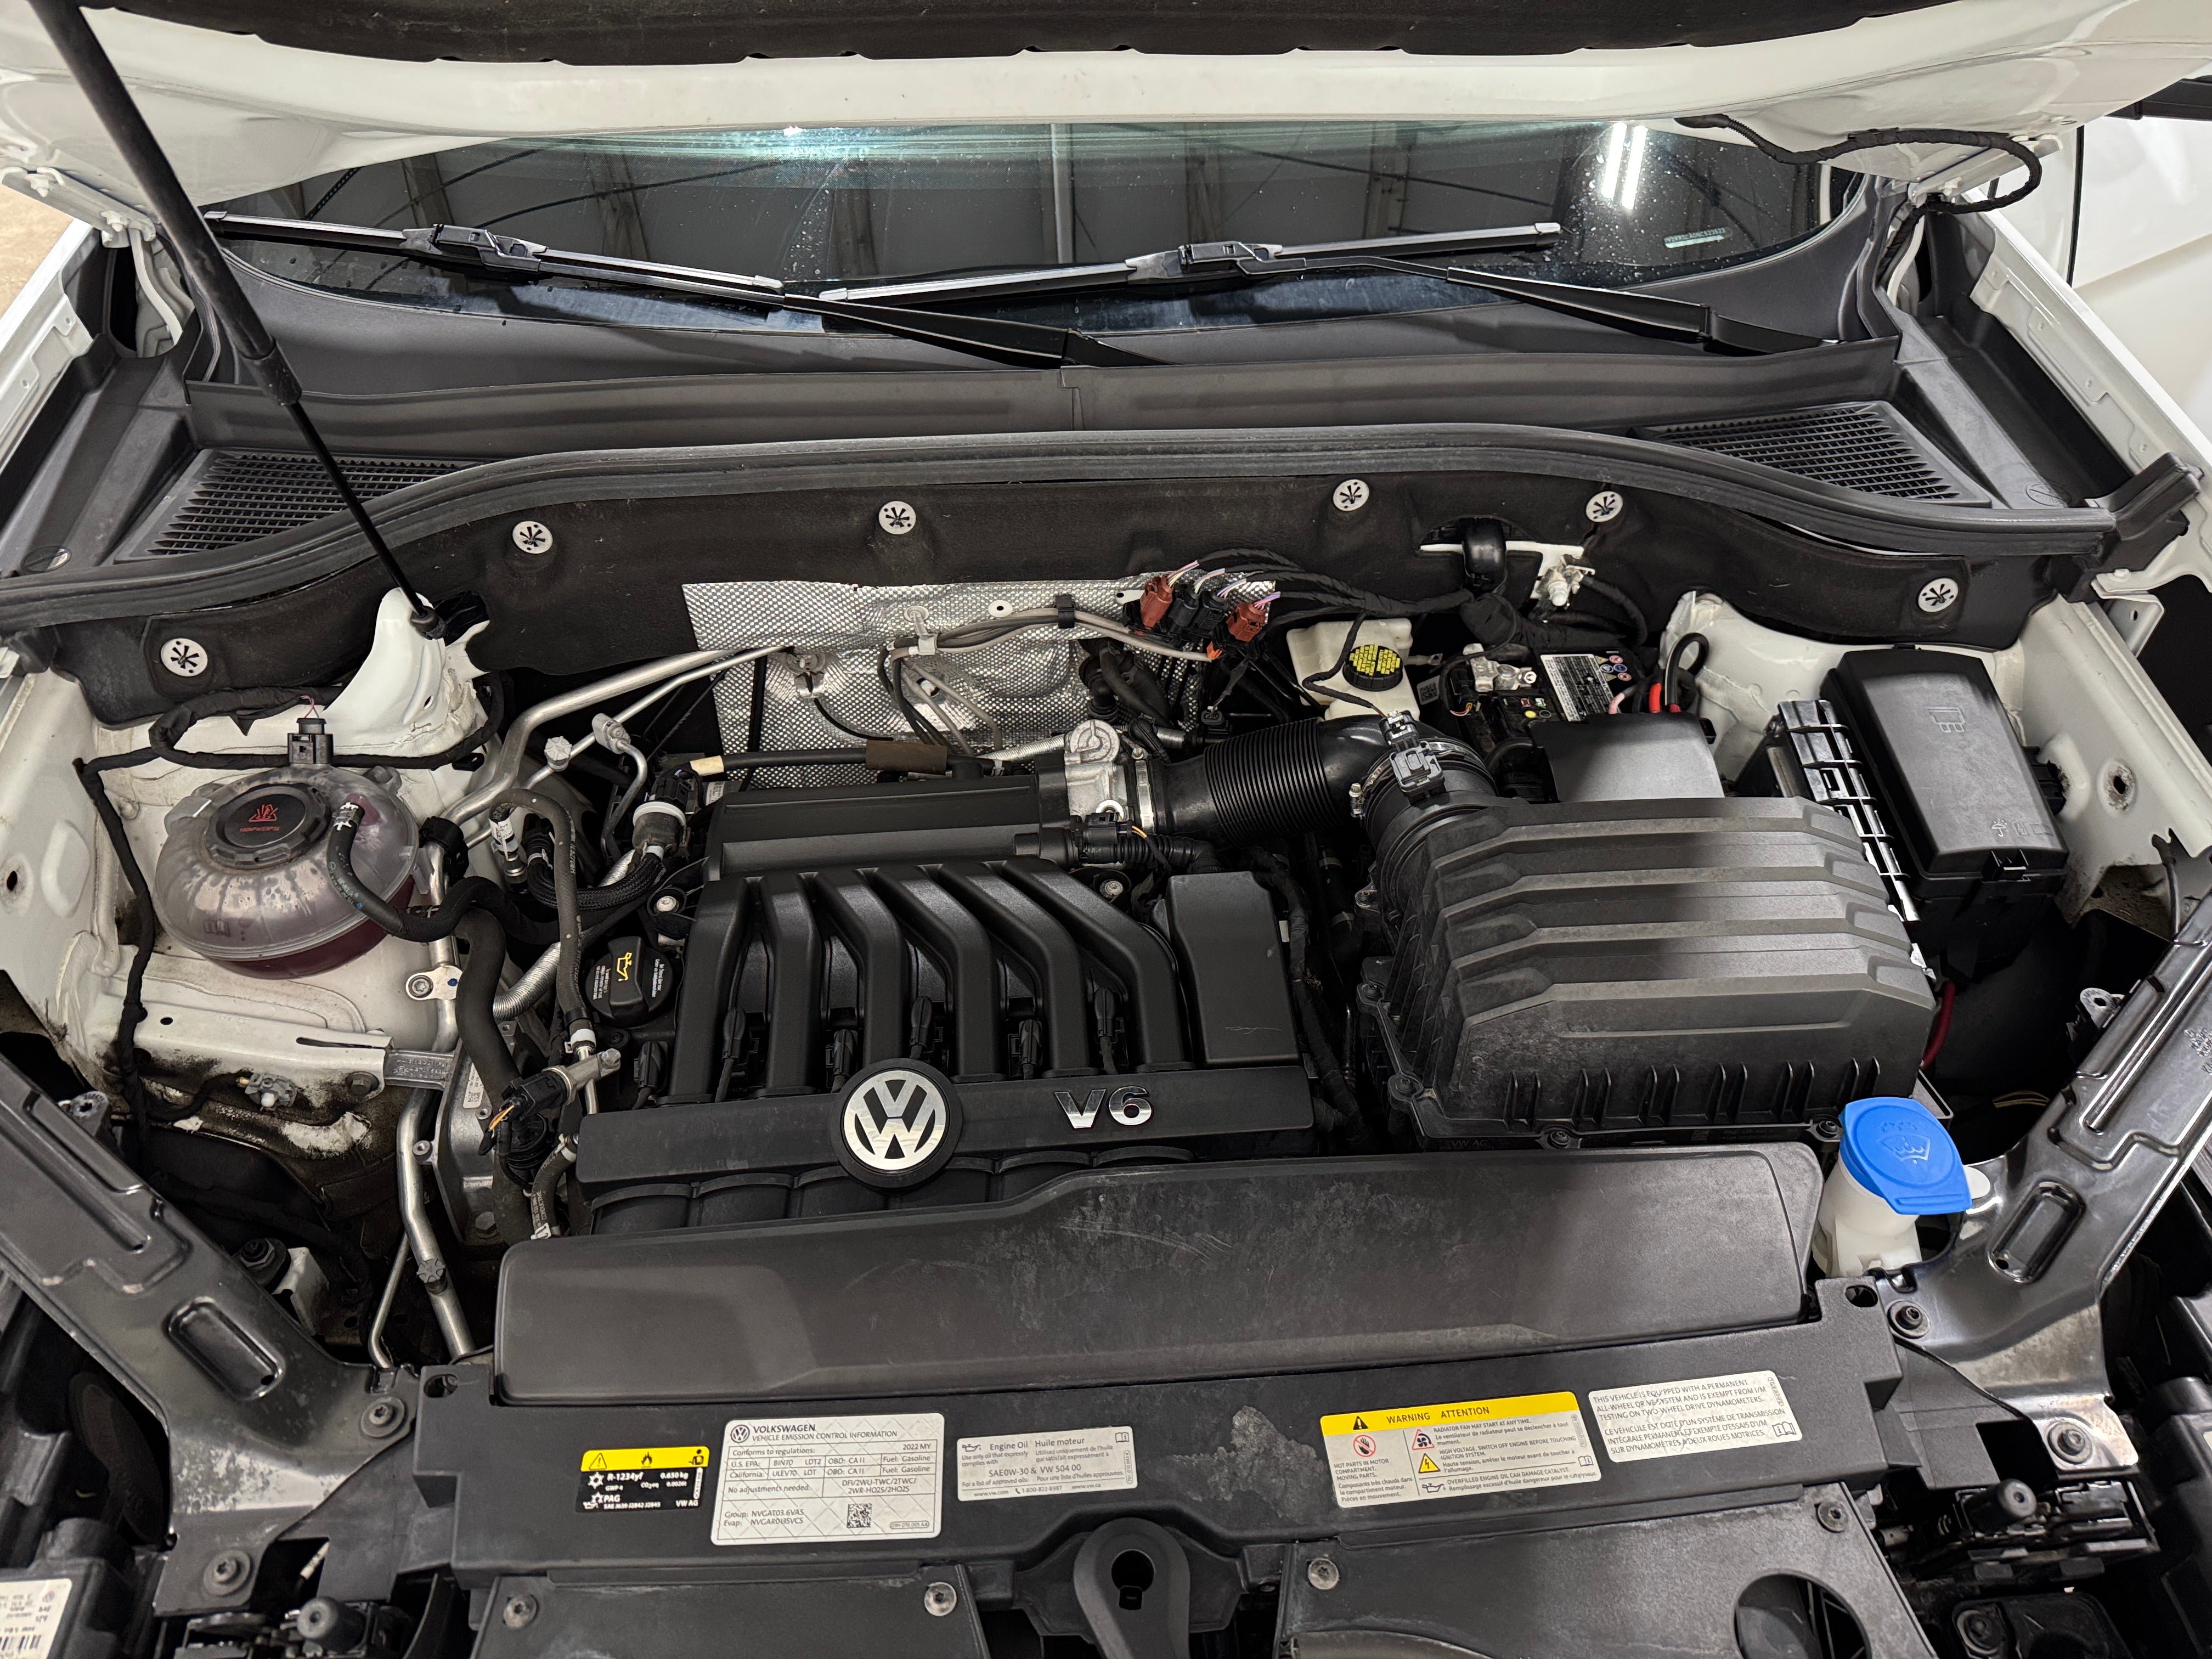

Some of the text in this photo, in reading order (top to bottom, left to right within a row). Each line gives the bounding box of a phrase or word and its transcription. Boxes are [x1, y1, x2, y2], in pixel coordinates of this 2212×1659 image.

[1053, 1085, 1153, 1130] V6
[1609, 1392, 1638, 1401] VEHICLE
[1707, 1379, 1748, 1390] PERMANENT
[1596, 1402, 1634, 1412] ALL-WHEEL
[1707, 1390, 1733, 1398] EXEMPT
[1599, 1412, 1628, 1420] TESTING
[1640, 1404, 1685, 1415] TWO-WHEEL
[1684, 1402, 1706, 1410] DRIVE
[1706, 1396, 1764, 1408] DYNAMOMETERS.
[1386, 1406, 1489, 1424] WARNING ATTENTION
[1736, 1408, 1785, 1419] TRANSMISSION
[753, 1424, 815, 1433] VOLKSWAGEN
[1707, 1433, 1730, 1442] ROUES
[1730, 1429, 1765, 1439] MOTRICES.
[990, 1442, 1015, 1452] Engine
[1035, 1439, 1055, 1447] Huile
[989, 1467, 1029, 1477] SAE0W-30
[1335, 1466, 1376, 1474] COMPARTMENT.
[607, 1471, 644, 1482] R-1234yf
[679, 1471, 689, 1480] kg
[1447, 1476, 1479, 1485] OVERFILLED
[739, 1485, 782, 1494] adjustments
[1346, 1486, 1384, 1494] compartiment
[603, 1494, 620, 1503] PAG
[724, 1511, 748, 1519] Group:
